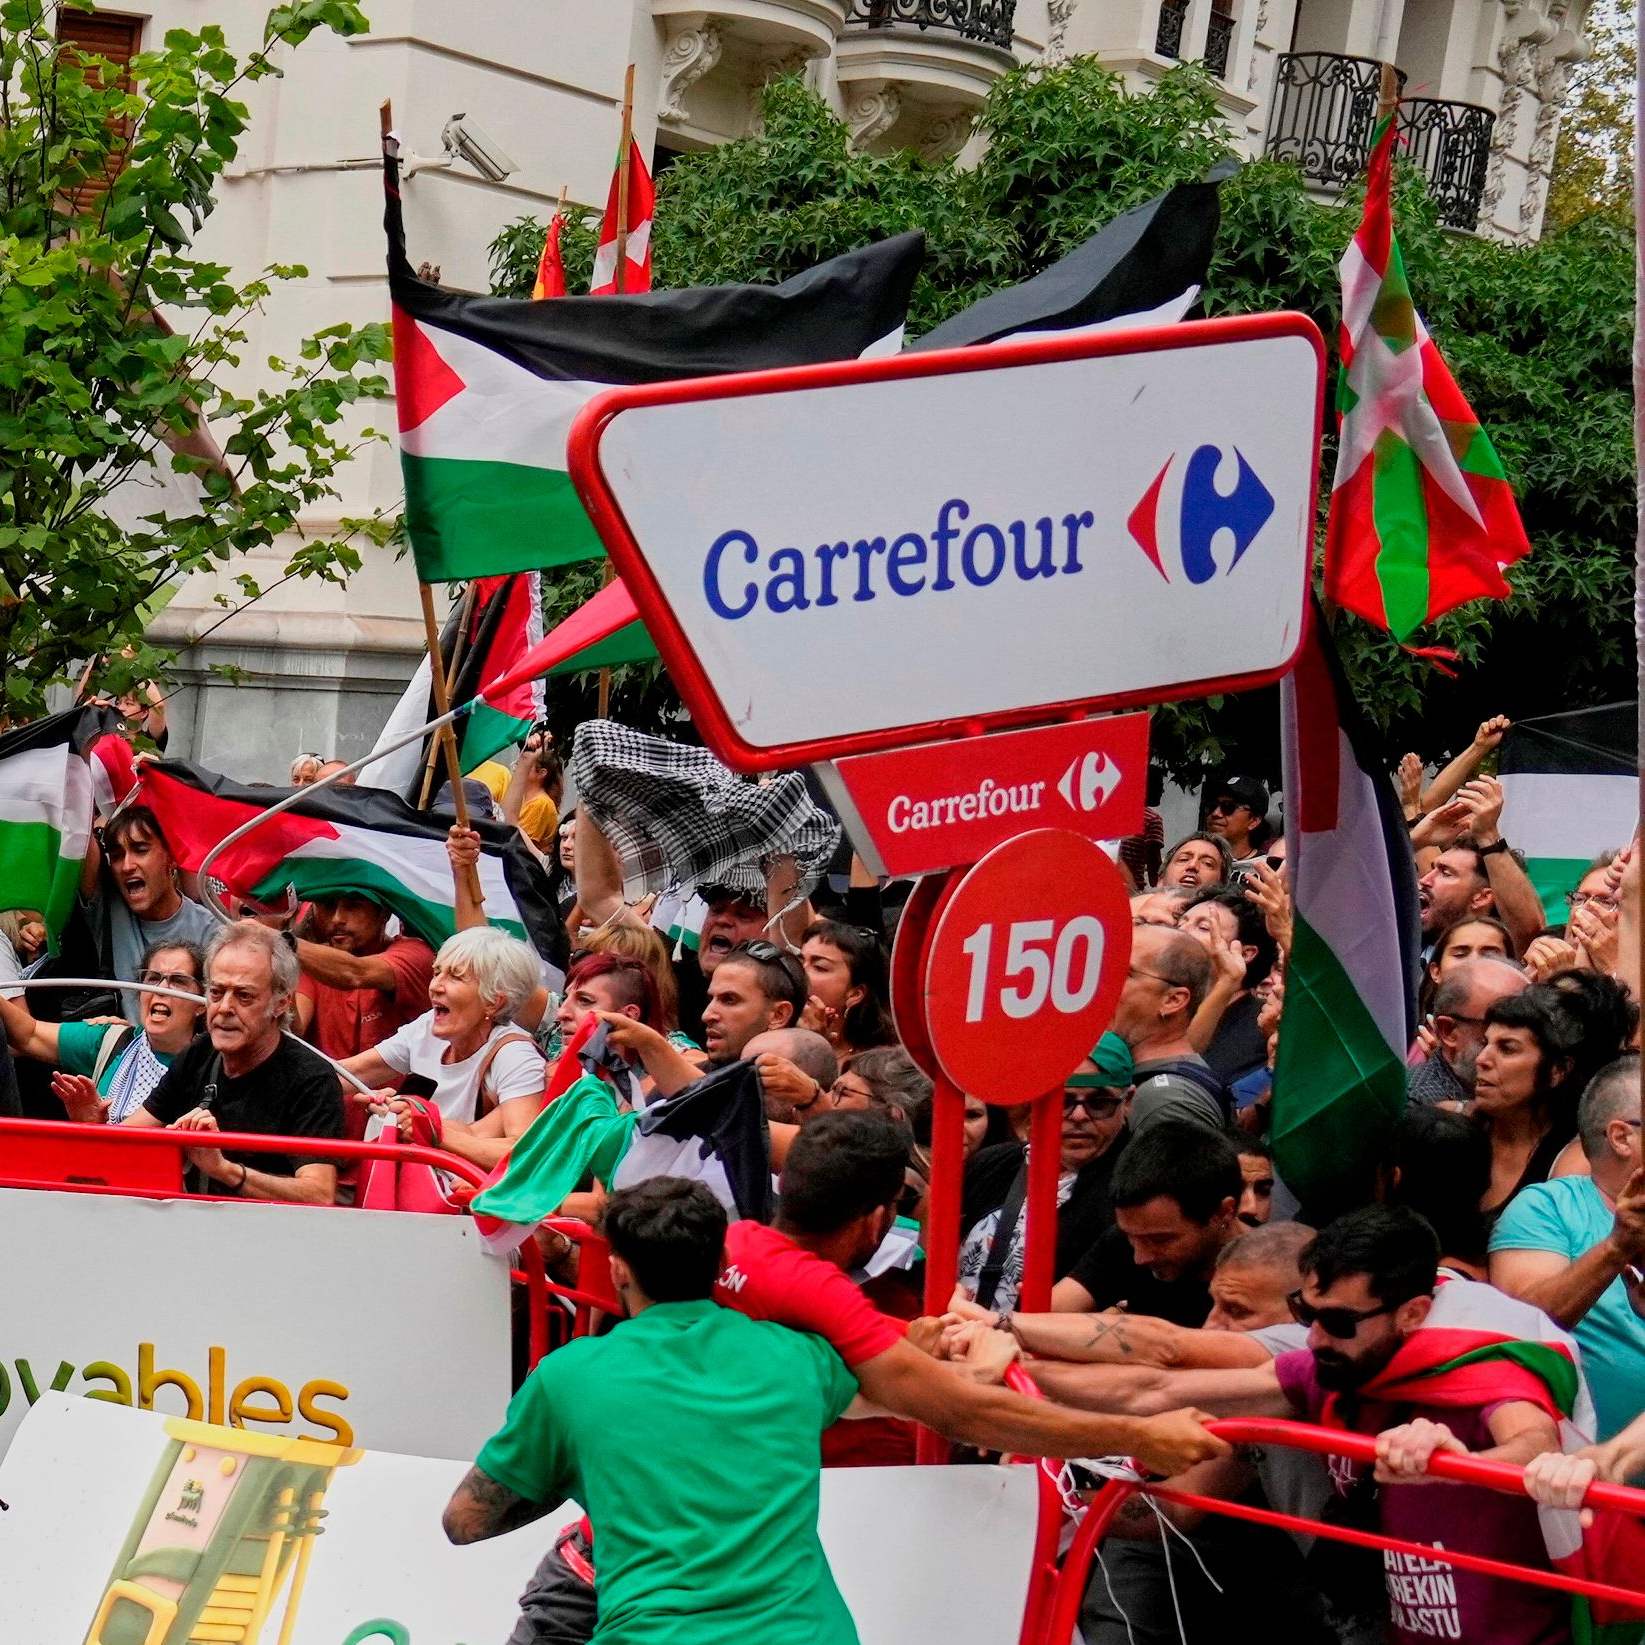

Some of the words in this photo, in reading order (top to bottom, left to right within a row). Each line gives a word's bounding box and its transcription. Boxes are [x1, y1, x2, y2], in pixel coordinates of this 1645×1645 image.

[703, 498, 1095, 621] Carrefour
[887, 777, 1045, 835] Carrefour
[960, 914, 1106, 1024] 150
